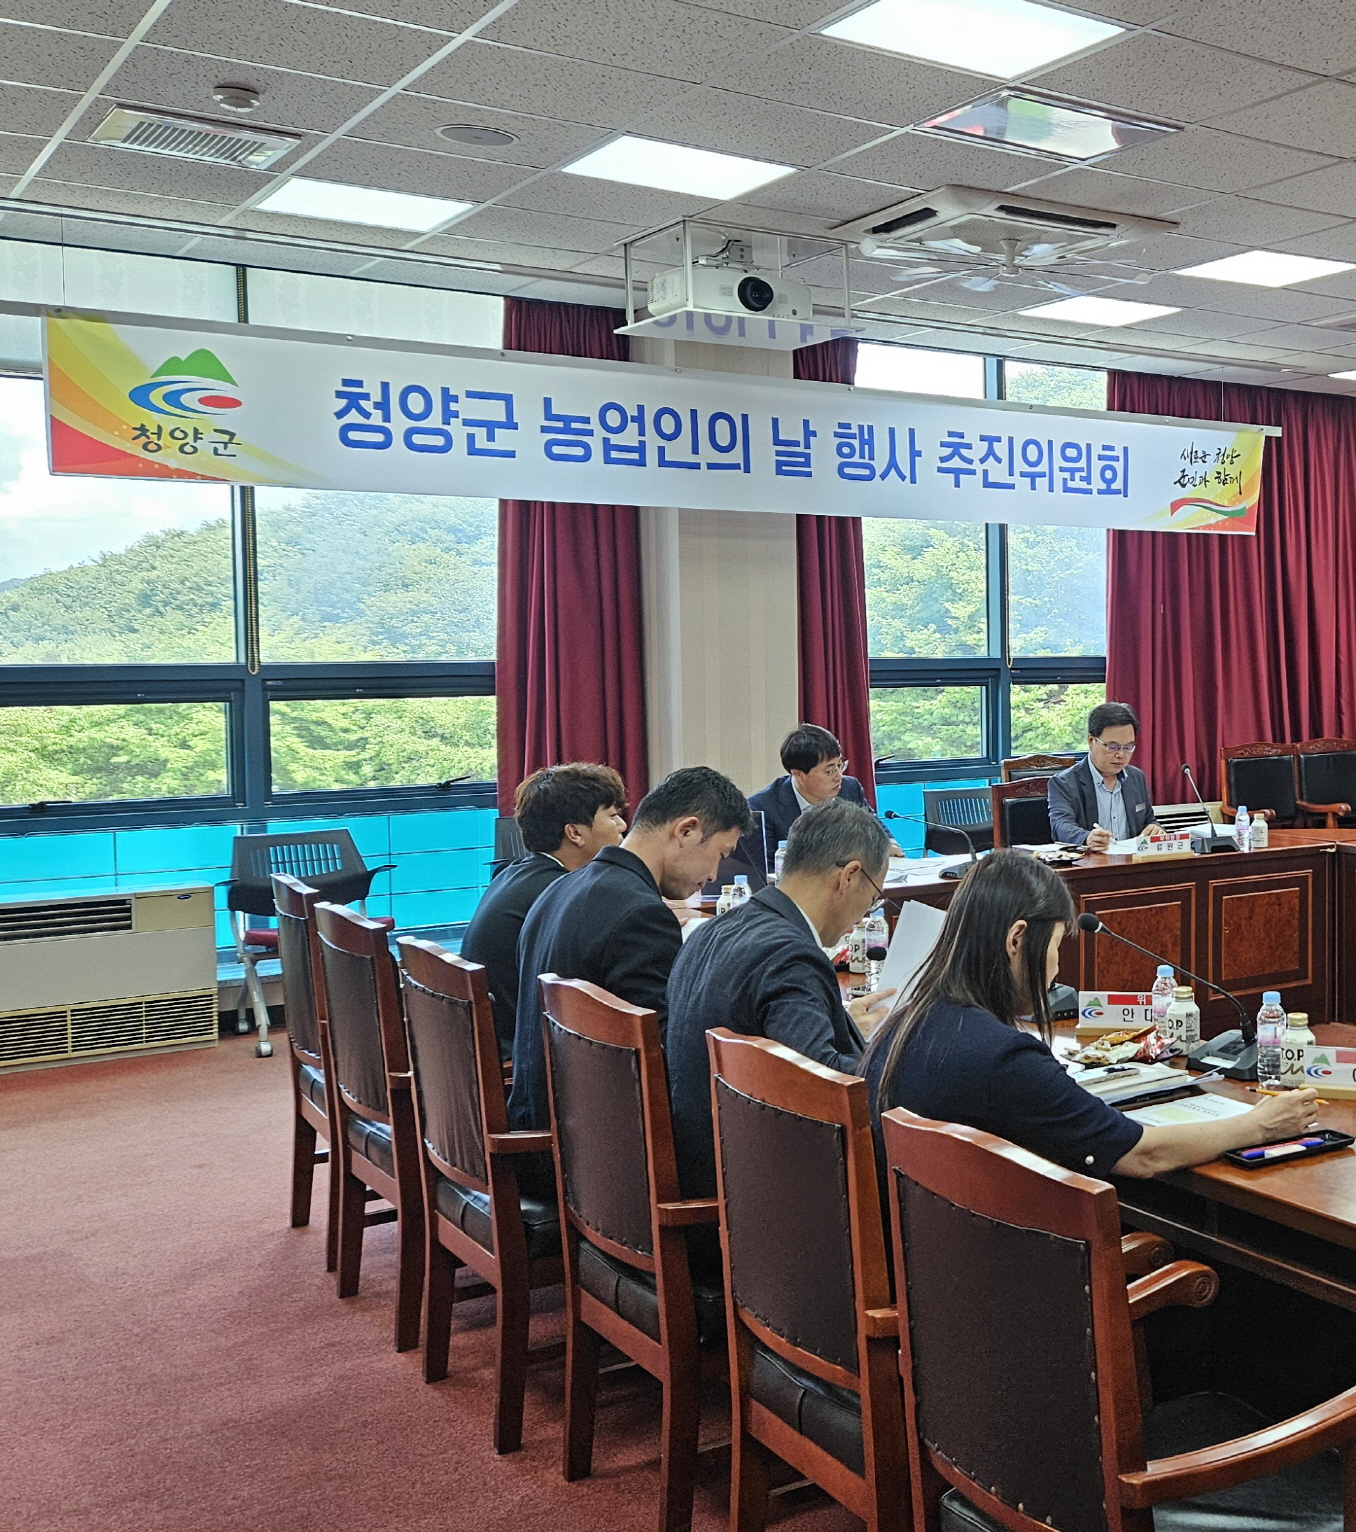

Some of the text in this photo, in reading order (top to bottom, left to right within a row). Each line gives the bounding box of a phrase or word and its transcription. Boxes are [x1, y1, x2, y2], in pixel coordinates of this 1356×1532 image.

[129, 421, 243, 458] 청양군
[334, 378, 1130, 498] 청양군 농업인의 날 행사 추진위원회
[1213, 446, 1241, 465] 청양
[1214, 467, 1243, 496] 함께
[1136, 994, 1147, 1005] 위
